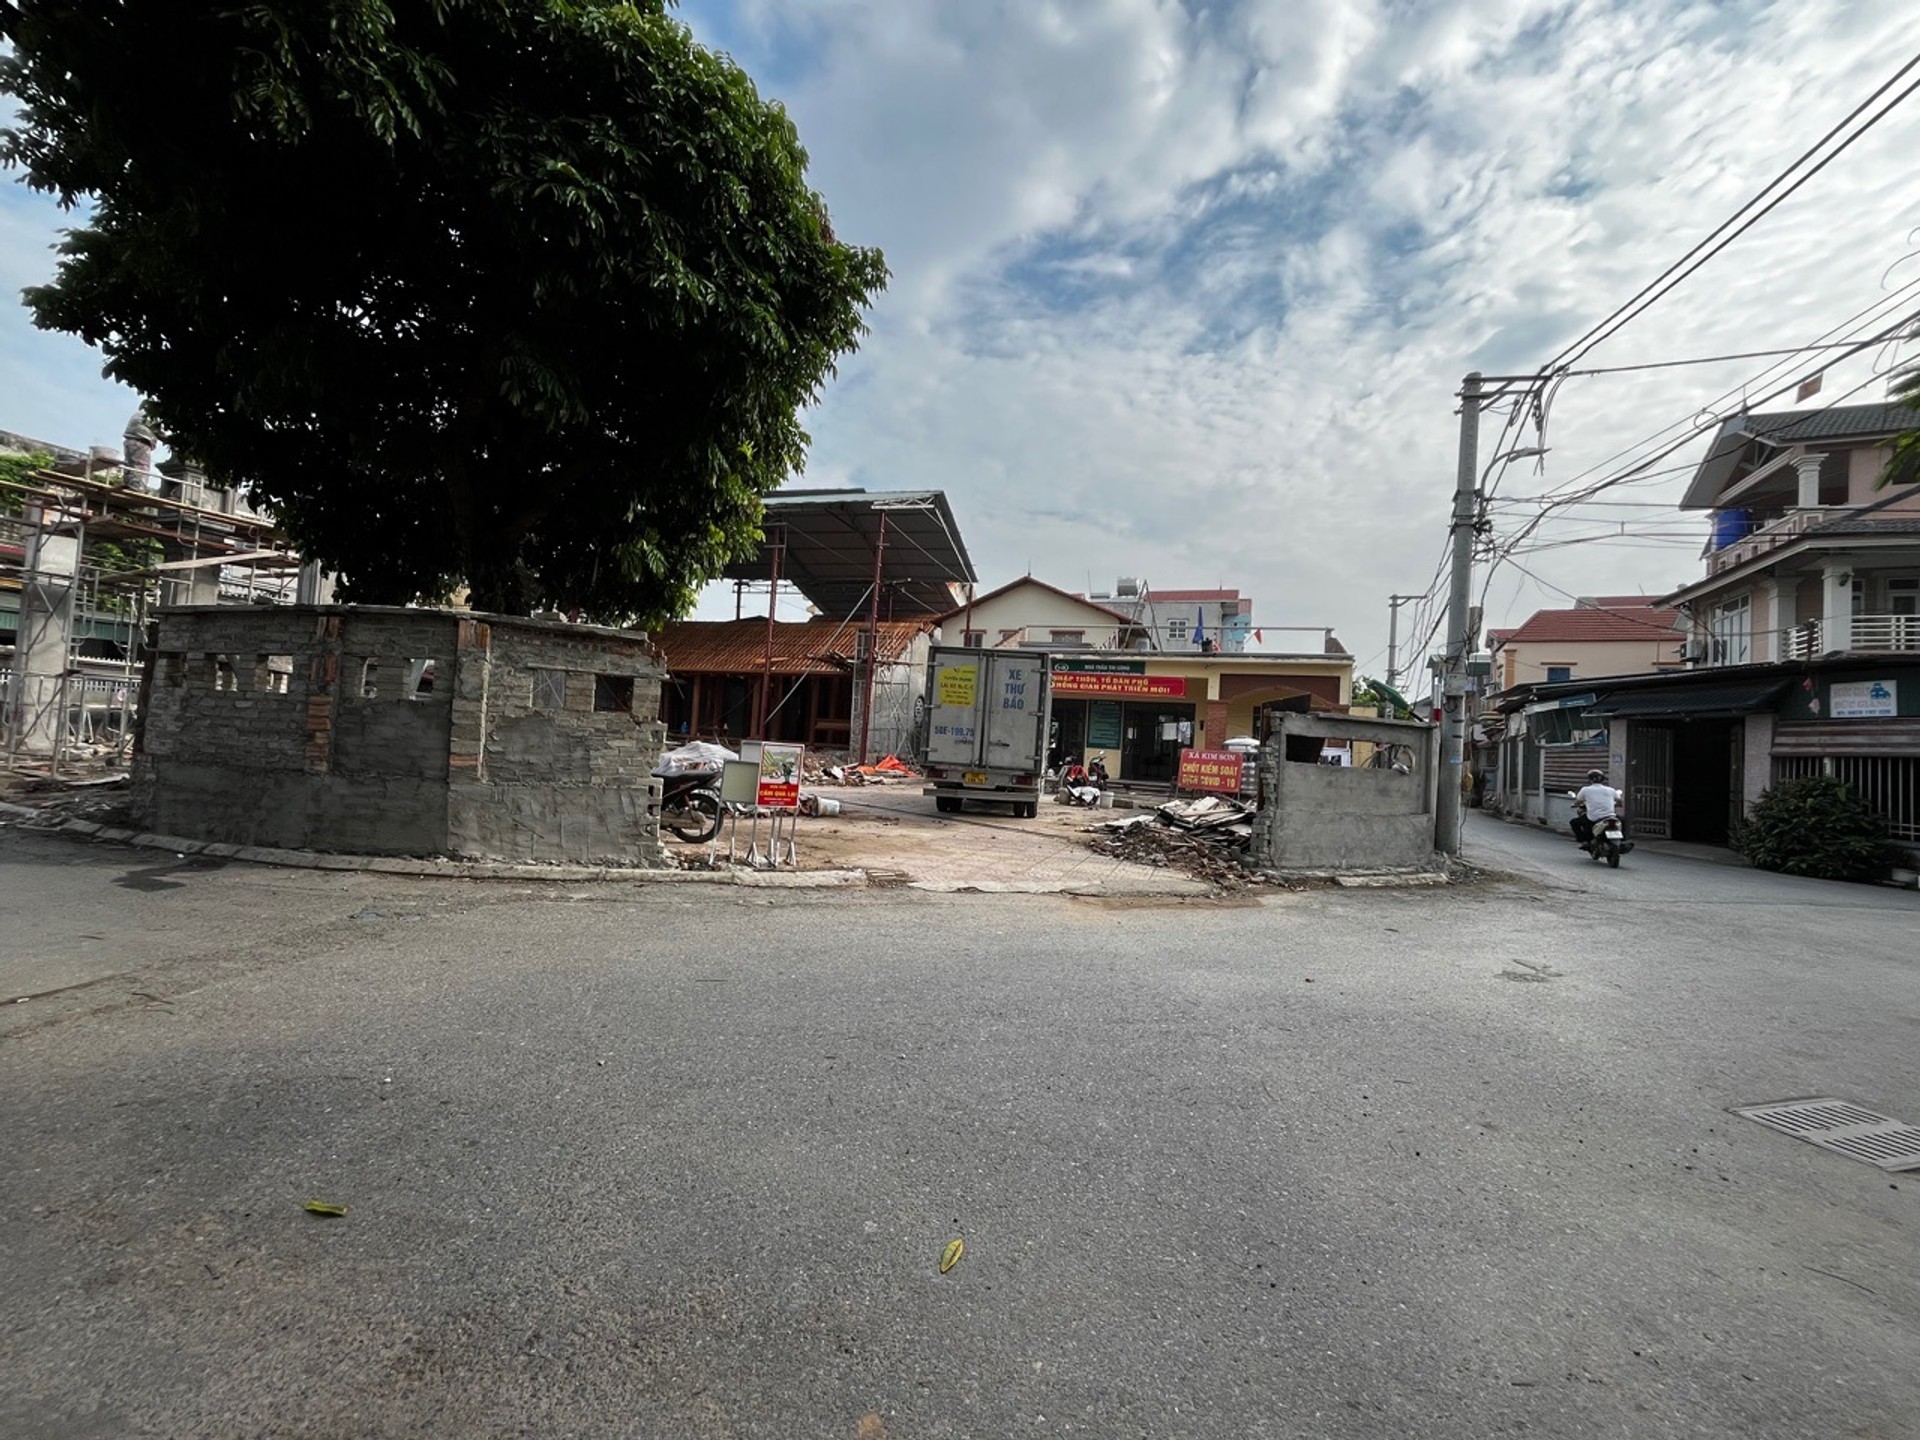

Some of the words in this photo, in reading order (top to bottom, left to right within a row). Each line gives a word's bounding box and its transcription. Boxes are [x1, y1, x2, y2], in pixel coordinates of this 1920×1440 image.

[1009, 669, 1022, 680] XE
[1005, 683, 1026, 695] THƯ
[1101, 683, 1123, 692] PHÁT
[1003, 698, 1025, 710] BÁO
[1201, 752, 1217, 760] KIM
[1182, 761, 1200, 773] CHỐT
[1201, 760, 1219, 775] KIỂM
[1220, 765, 1238, 776] SOÁT
[1200, 775, 1220, 786] COVID
[1227, 778, 1236, 788] 19
